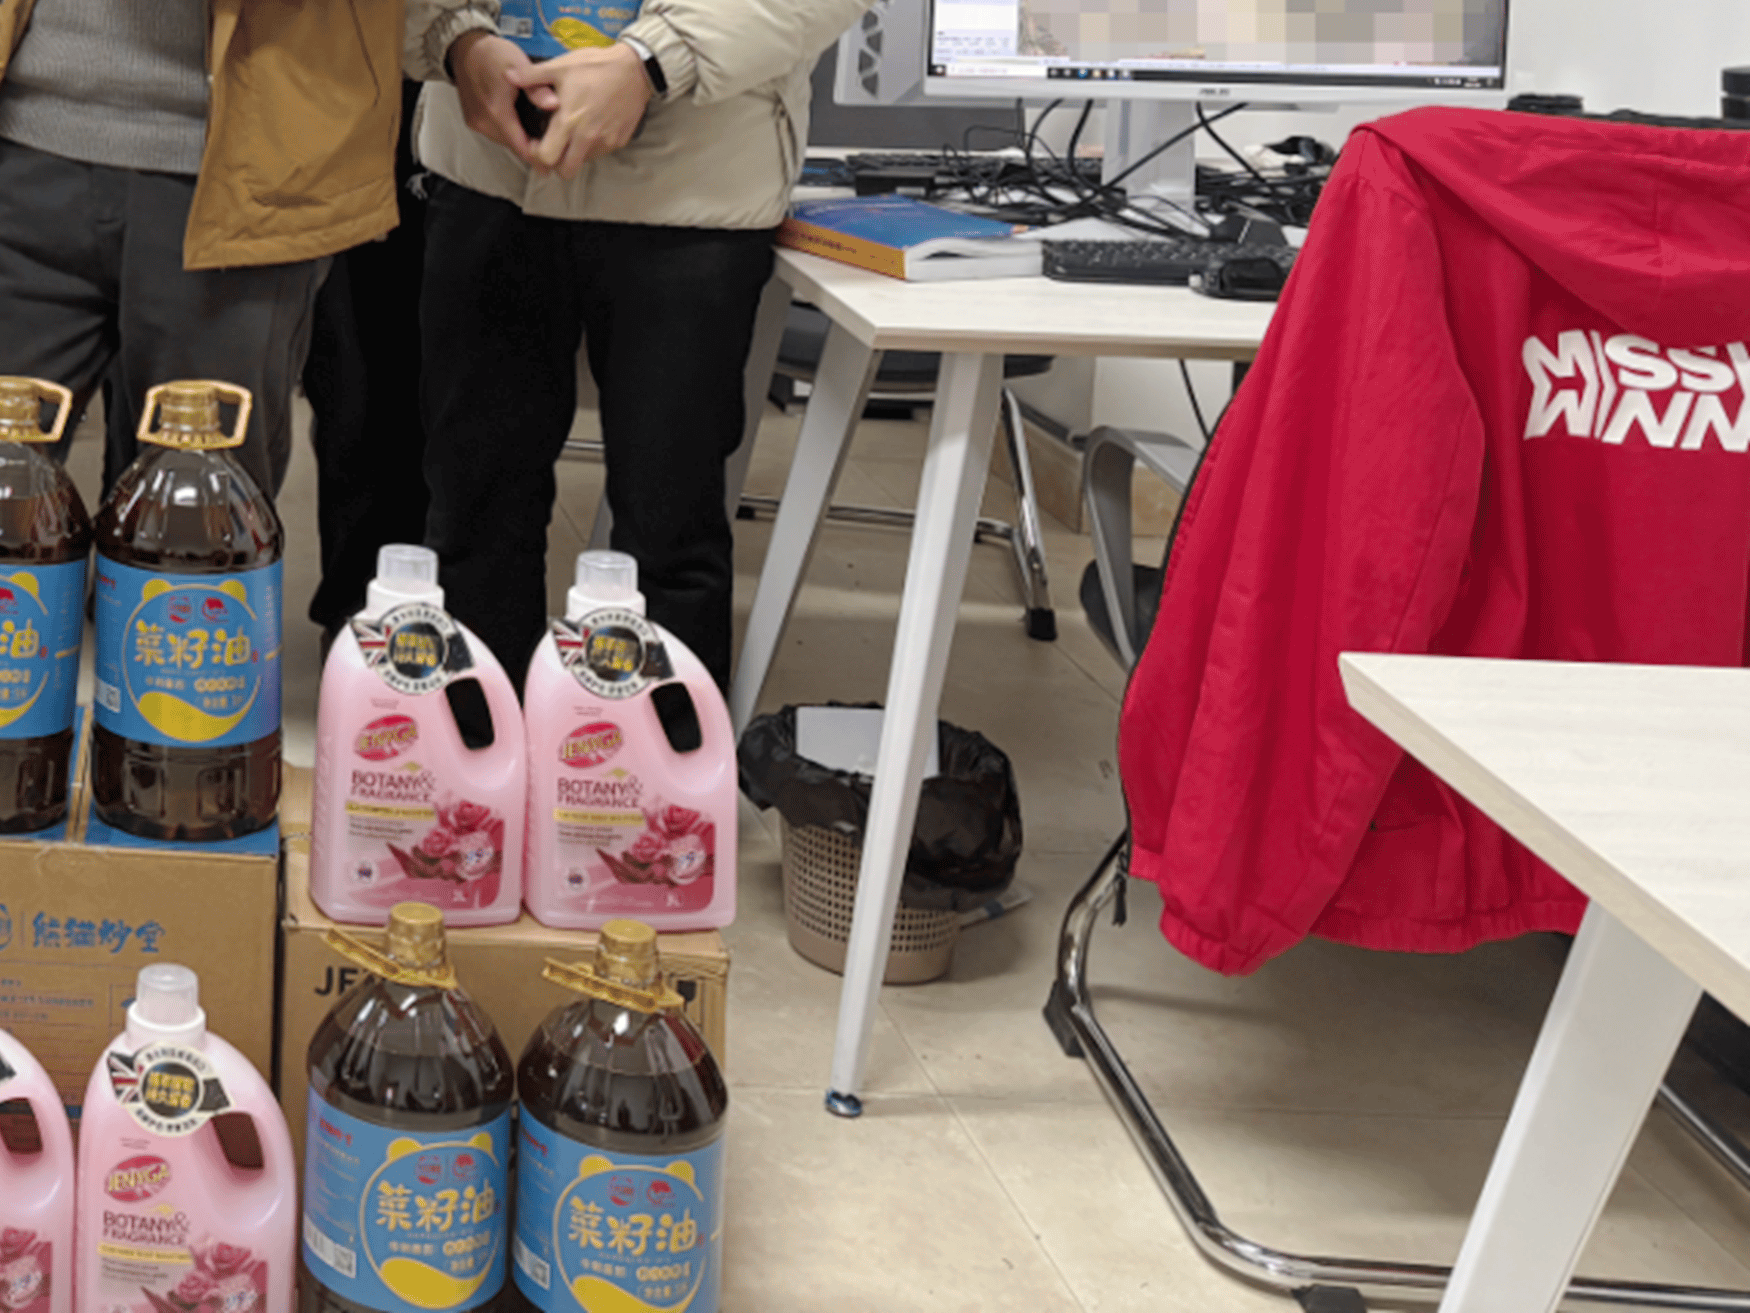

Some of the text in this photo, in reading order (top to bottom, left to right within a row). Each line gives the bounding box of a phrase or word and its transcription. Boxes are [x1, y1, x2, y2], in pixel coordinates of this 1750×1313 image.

[134, 619, 250, 669] 菜籽油
[376, 1179, 494, 1233] 菜籽油
[568, 1196, 697, 1257] 菜籽油
